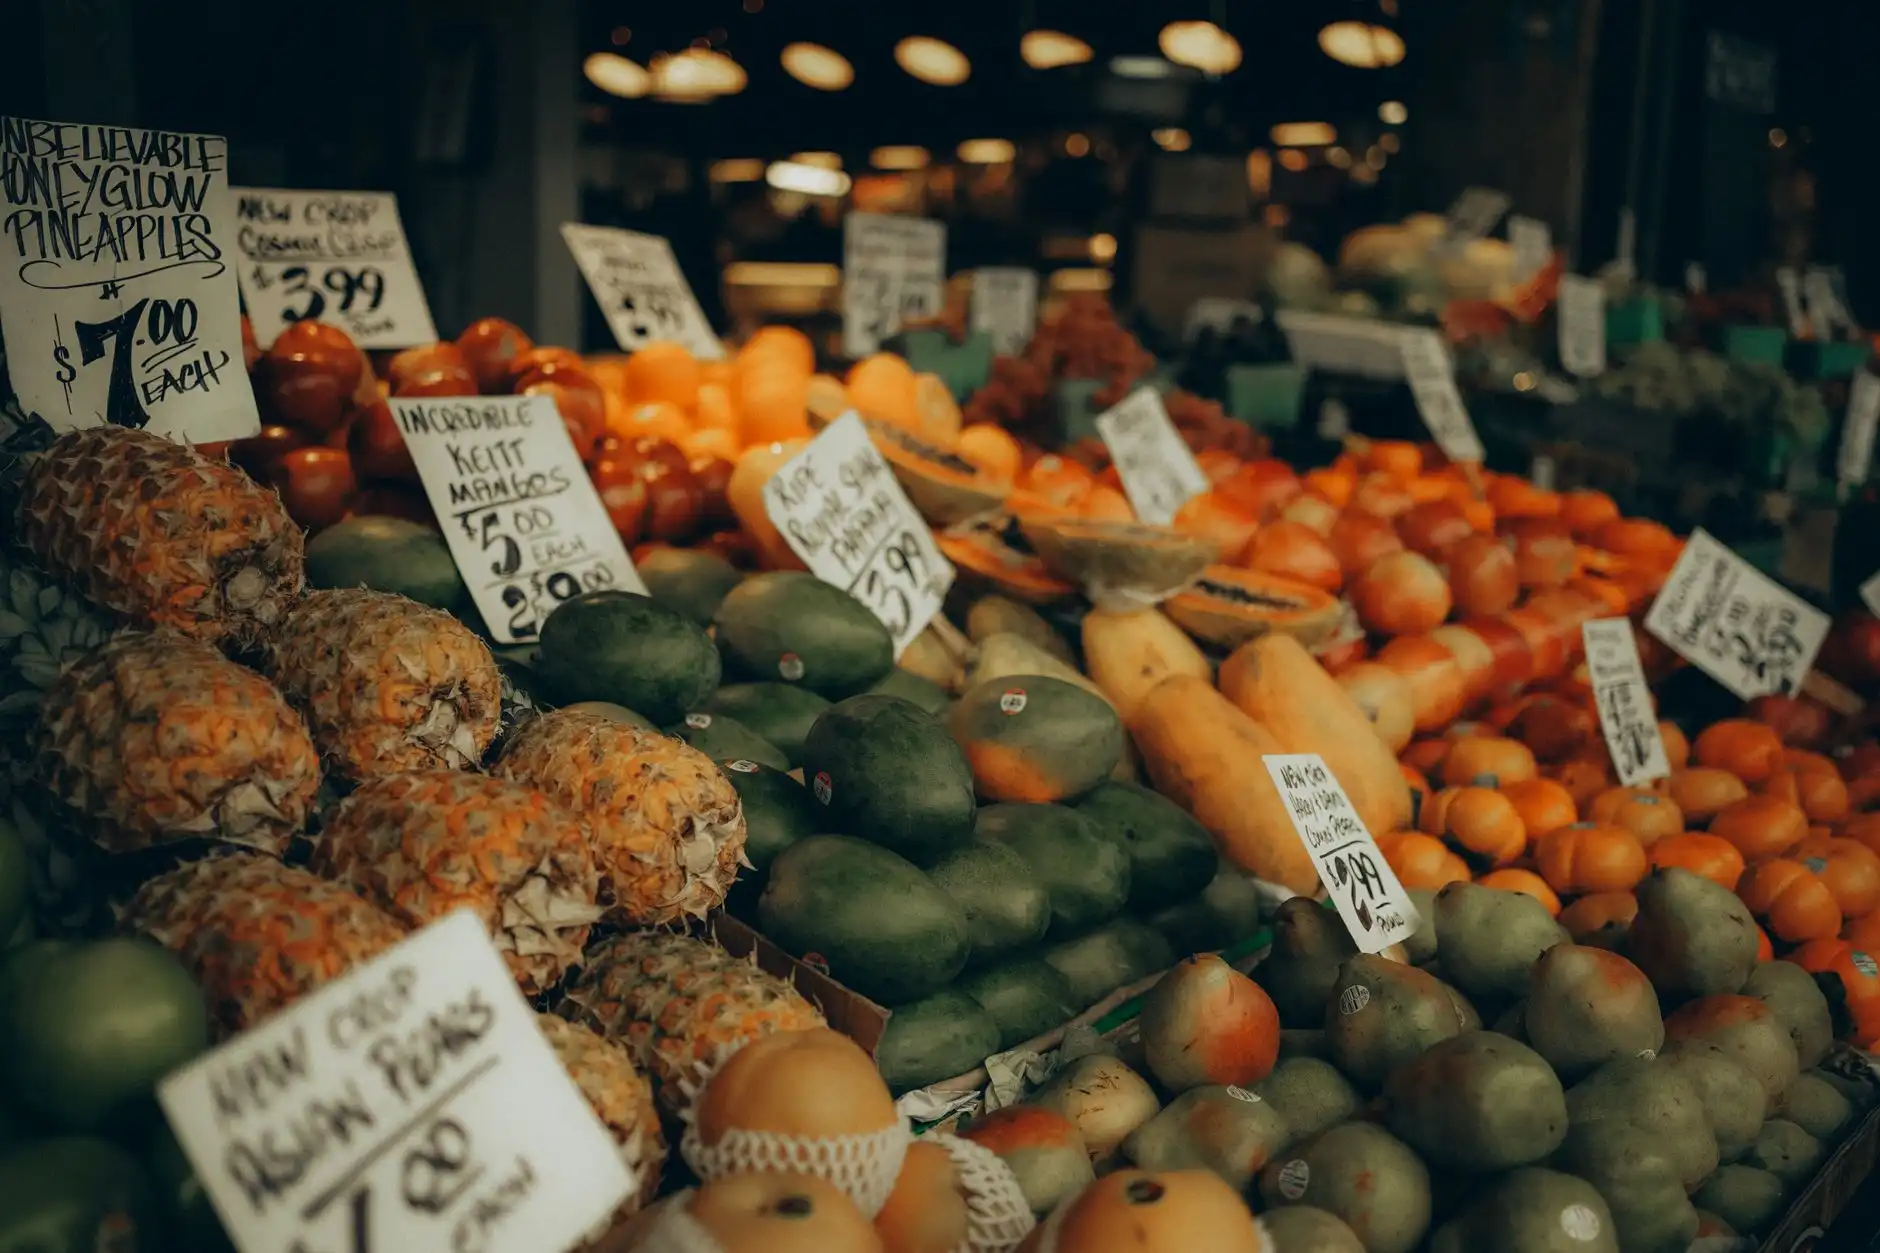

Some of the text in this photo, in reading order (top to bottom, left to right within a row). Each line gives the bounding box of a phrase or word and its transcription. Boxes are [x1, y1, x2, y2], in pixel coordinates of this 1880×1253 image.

[0, 115, 226, 172] NBELIEVABLE
[4, 209, 222, 262] PINEAPPLES
[141, 350, 229, 405] EACH
[445, 437, 525, 477] KEITT
[530, 535, 587, 567] EACH
